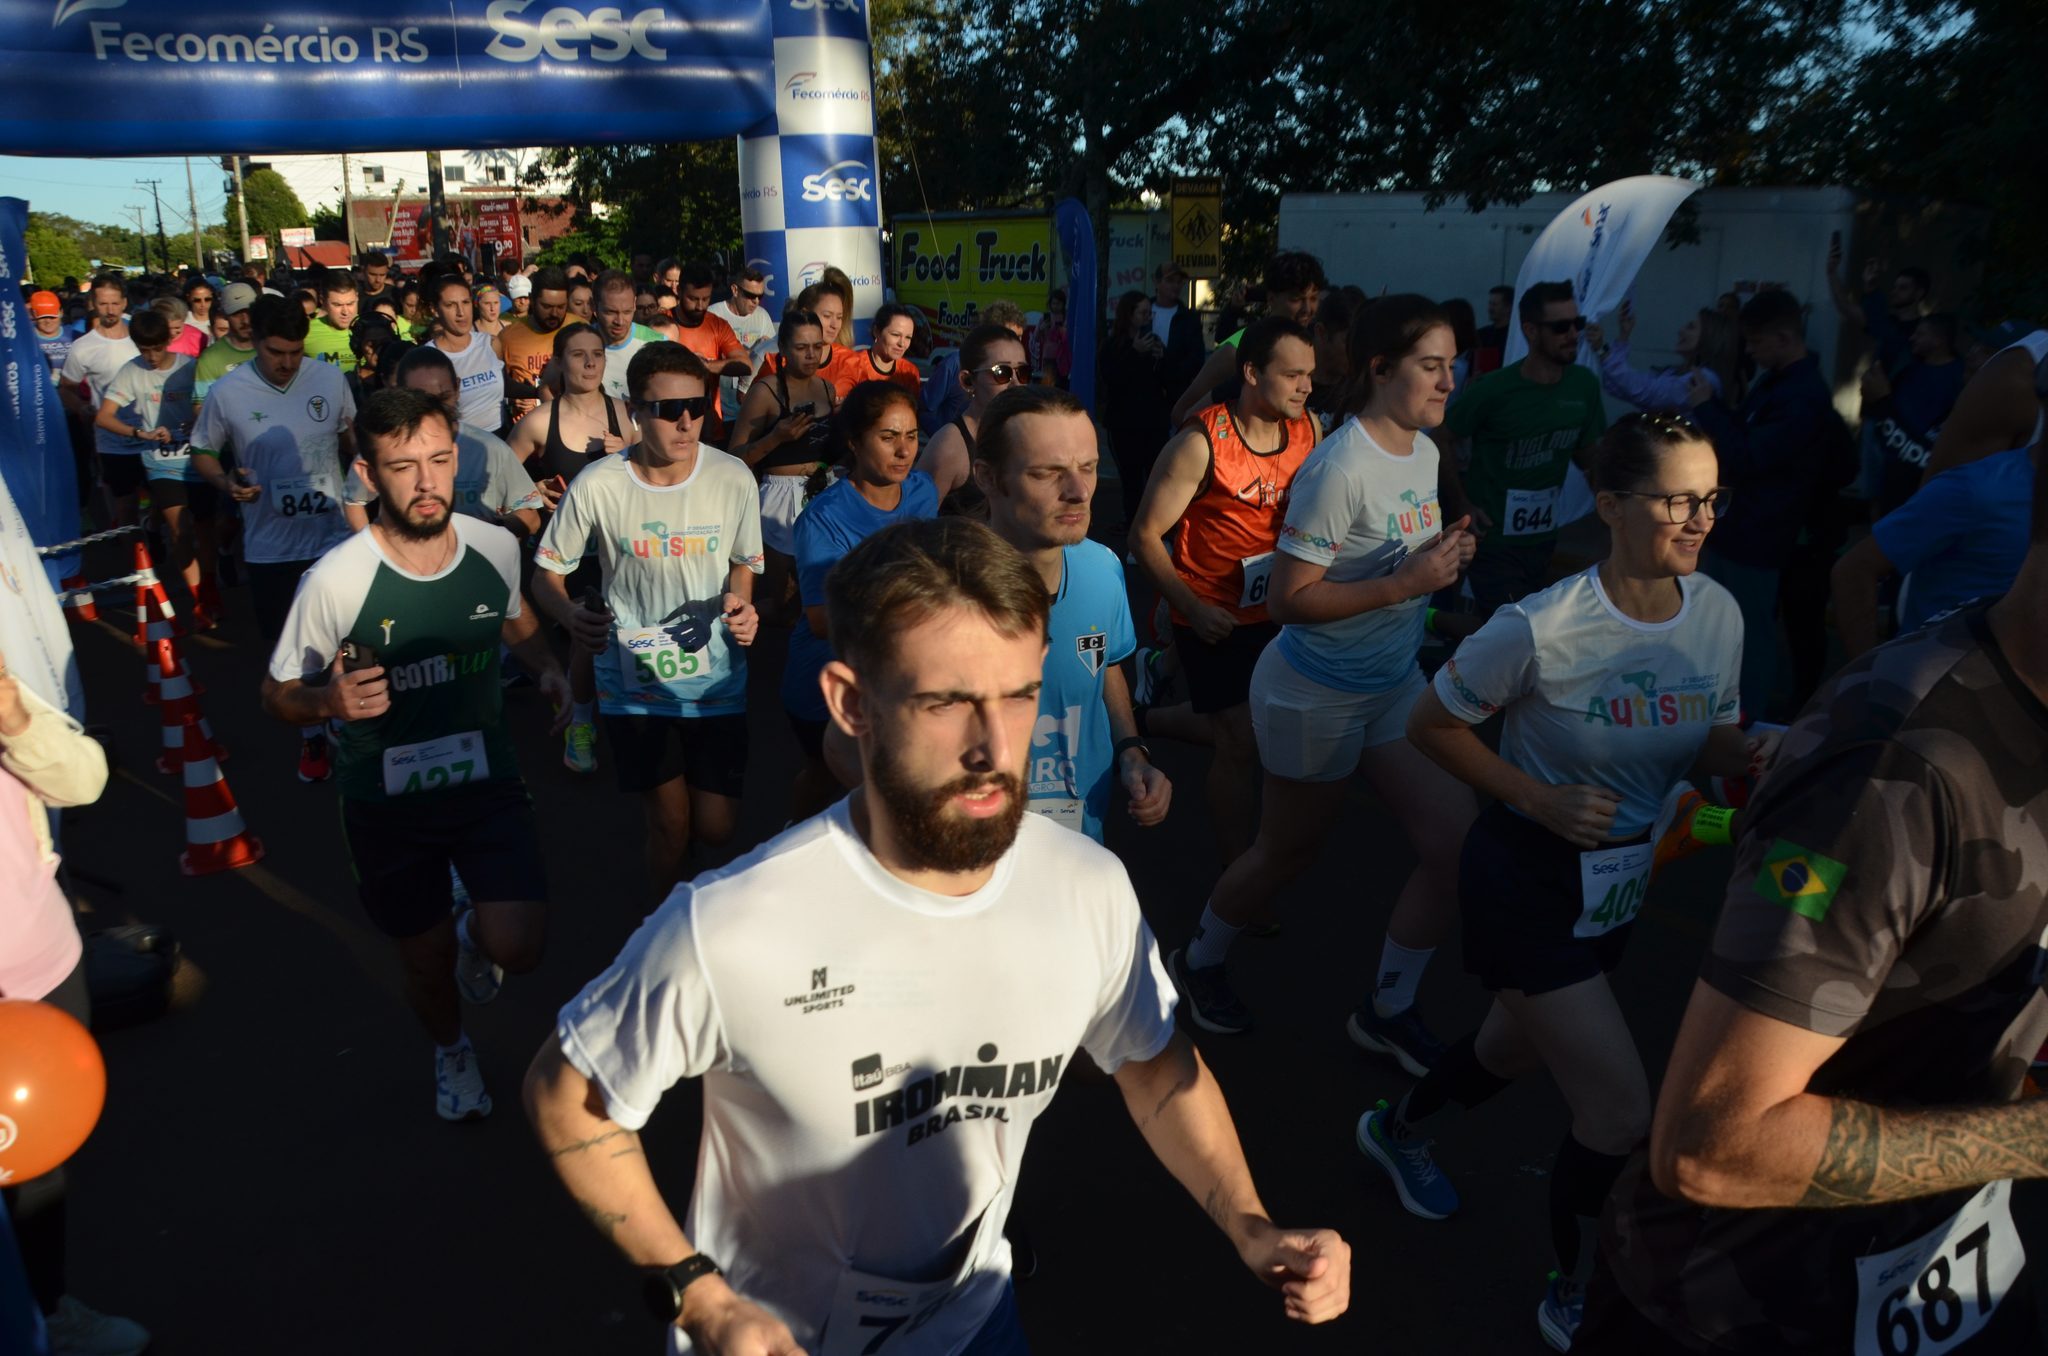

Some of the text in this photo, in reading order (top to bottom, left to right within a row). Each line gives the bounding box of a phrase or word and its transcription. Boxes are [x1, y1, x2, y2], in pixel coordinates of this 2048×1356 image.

[89, 22, 429, 63] Fecomércio RS
[484, 0, 668, 62] Sesc
[792, 88, 871, 102] Fecomércio RS
[763, 187, 778, 198] RS
[801, 174, 871, 202] Sesc
[900, 232, 962, 281] Food
[975, 231, 1046, 282] Truck
[1176, 253, 1218, 267] ELEVADA
[461, 369, 497, 388] ETRIA
[282, 491, 329, 517] 842
[1512, 503, 1553, 532] 644
[619, 535, 719, 559] Autismo
[628, 638, 655, 649] Sesc
[635, 648, 699, 684] 565
[404, 759, 474, 793] 427
[1592, 862, 1620, 875] Sesc
[1590, 868, 1650, 927] 409
[784, 984, 855, 1006] UNLIMITED
[802, 998, 844, 1014] SPORTS
[854, 1062, 912, 1088] Itaú BBA
[854, 1053, 1064, 1137] IRONMAN
[907, 1104, 1010, 1147] BRASIL
[1877, 1220, 1993, 1356] 687
